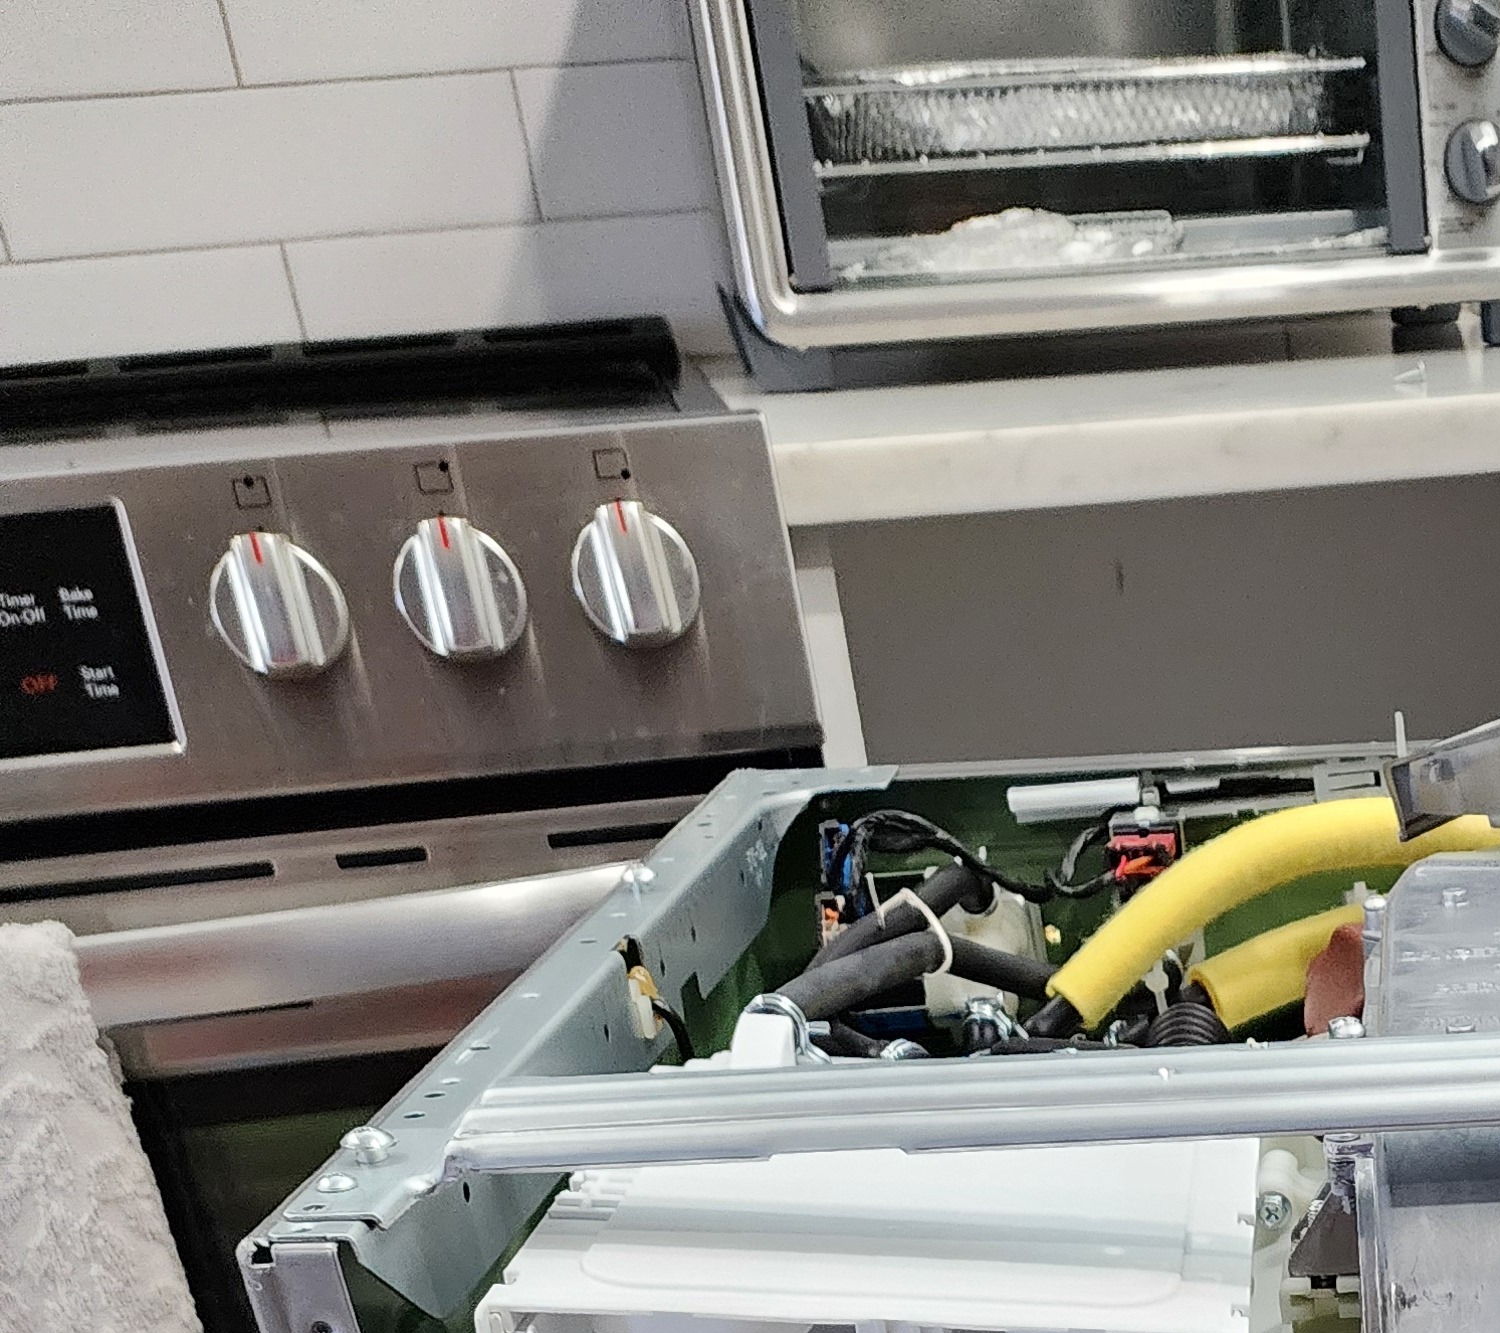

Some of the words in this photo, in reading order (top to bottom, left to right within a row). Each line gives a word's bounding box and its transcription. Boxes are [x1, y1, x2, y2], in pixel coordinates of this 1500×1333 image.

[58, 586, 94, 602] Bake
[63, 604, 98, 620] Time
[79, 664, 115, 681] Start
[84, 682, 120, 698] Time
